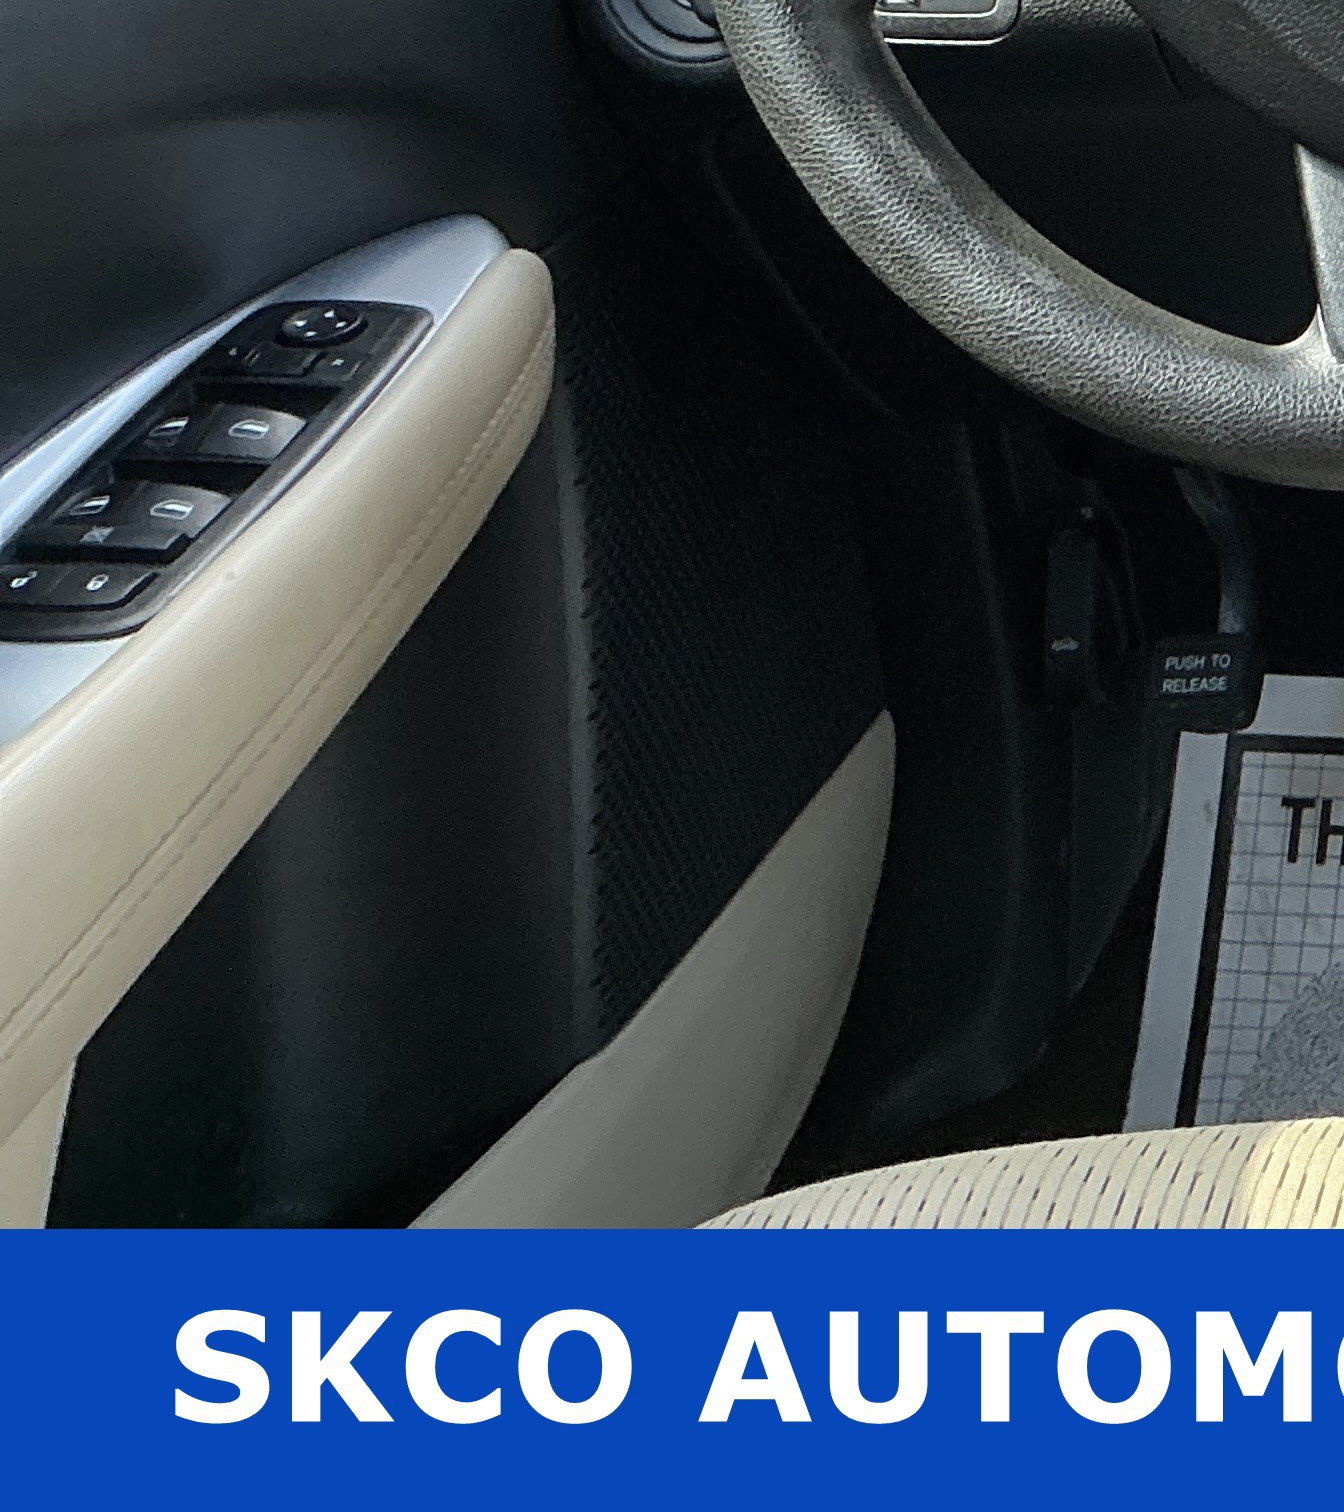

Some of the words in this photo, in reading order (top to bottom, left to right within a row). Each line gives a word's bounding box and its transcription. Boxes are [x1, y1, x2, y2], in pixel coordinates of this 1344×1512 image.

[1165, 655, 1205, 672] PUSH
[1211, 653, 1231, 669] TO
[1162, 675, 1229, 694] RELEASE
